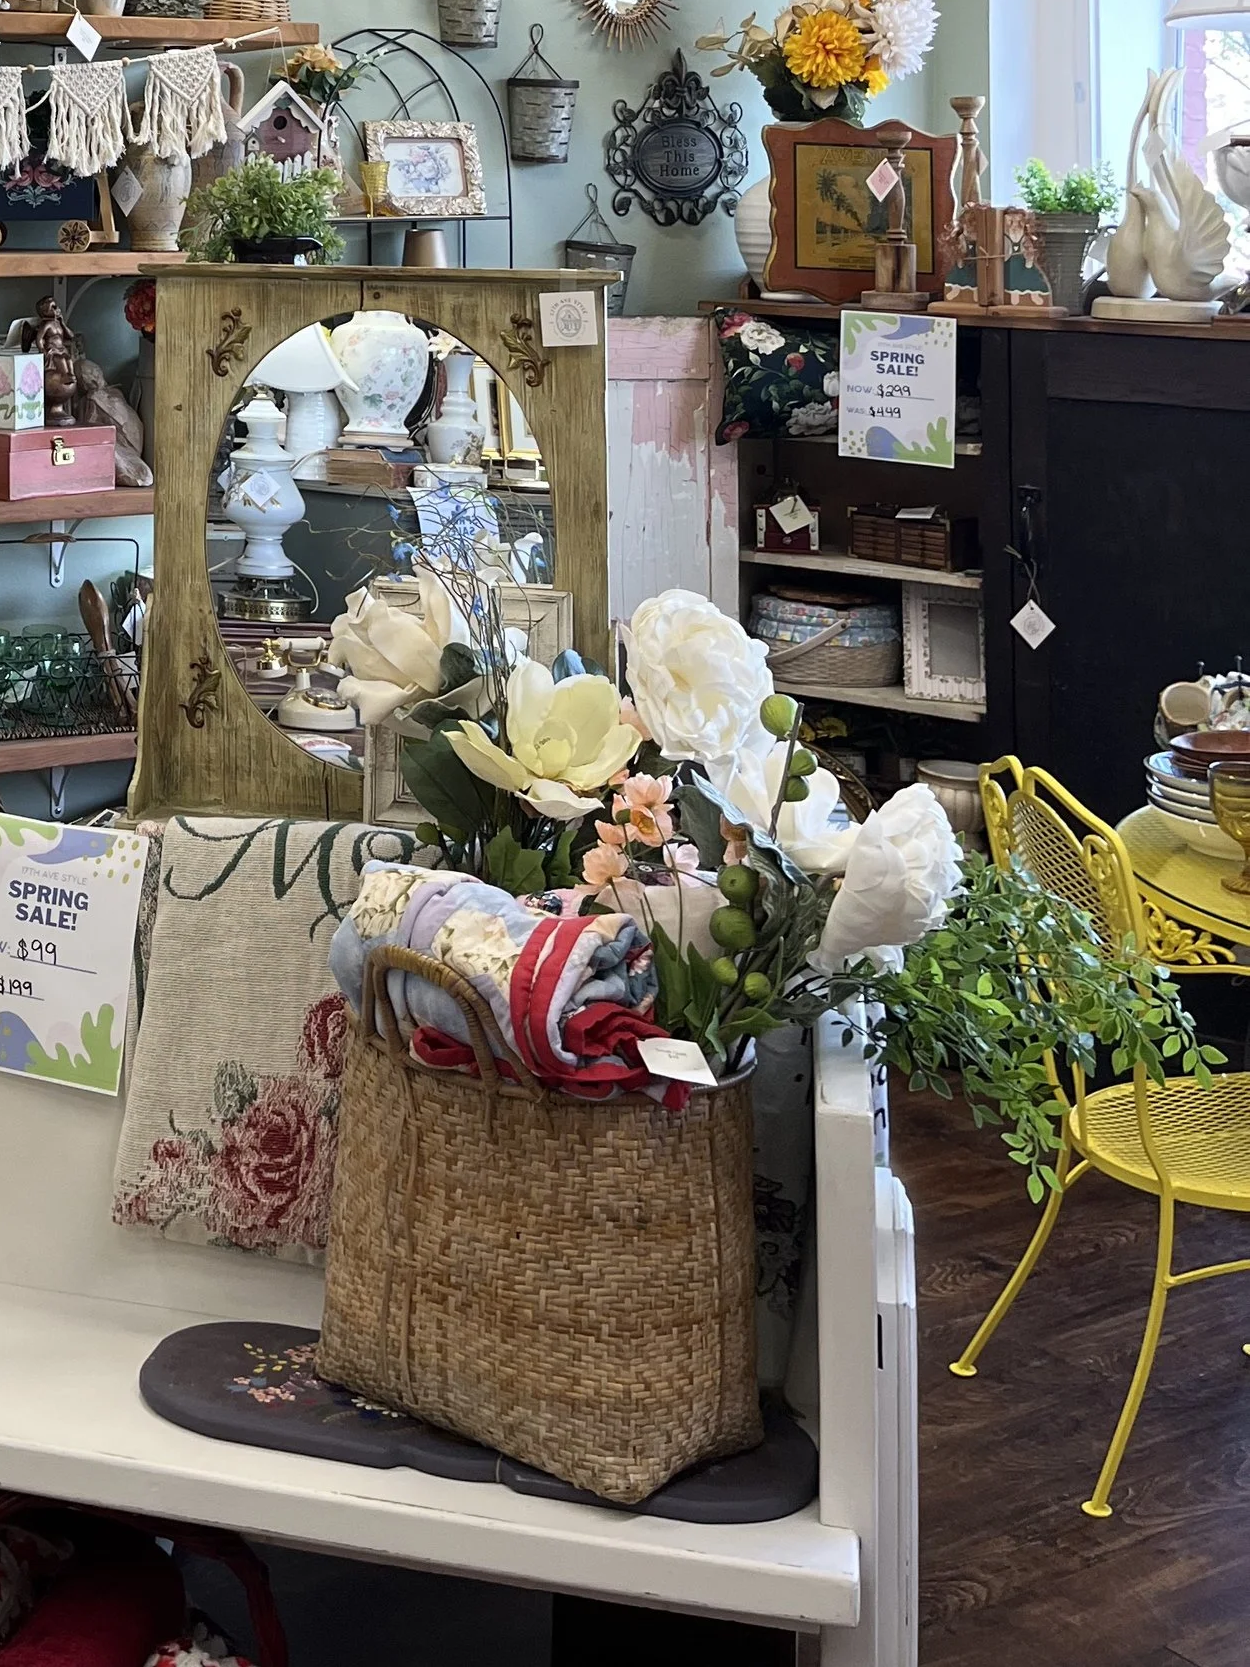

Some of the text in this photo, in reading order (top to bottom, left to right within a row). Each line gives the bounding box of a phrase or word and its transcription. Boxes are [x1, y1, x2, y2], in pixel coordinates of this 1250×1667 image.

[661, 136, 697, 147] Bless
[664, 151, 695, 162] This
[660, 165, 700, 176] Home
[870, 350, 925, 365] SPRING
[876, 364, 919, 376] SALE!
[877, 384, 911, 398] $299
[869, 406, 901, 419] $449
[42, 869, 59, 880] AVE
[62, 873, 87, 885] STYLE
[8, 880, 89, 911] SPRING
[15, 903, 77, 931] SALE!
[17, 938, 57, 965] $99
